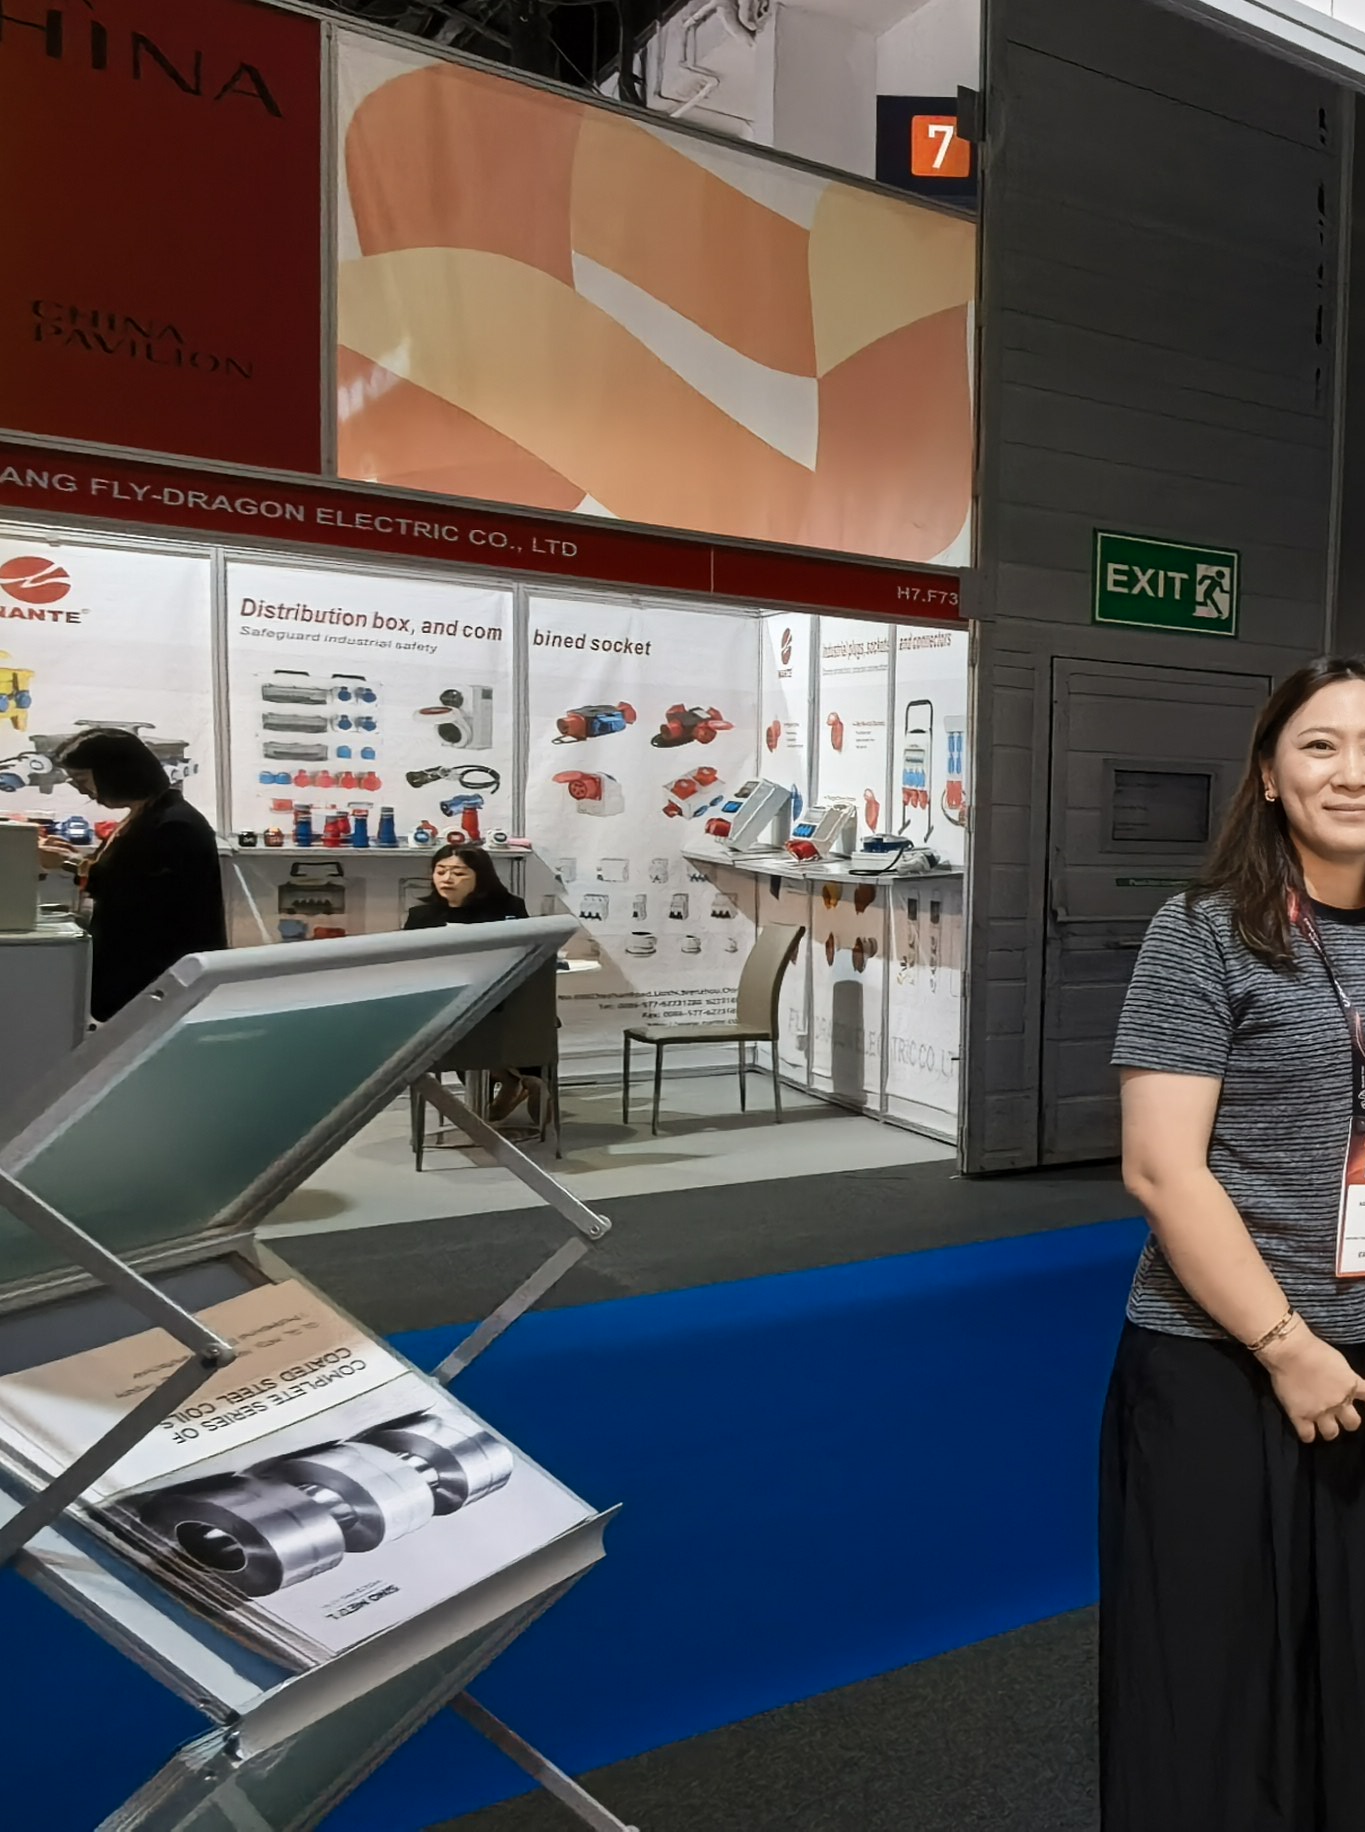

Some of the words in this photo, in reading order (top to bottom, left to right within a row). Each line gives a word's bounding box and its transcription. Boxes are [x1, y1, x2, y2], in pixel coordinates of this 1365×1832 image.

[928, 124, 954, 168] 7
[32, 300, 183, 345] CHINA
[35, 322, 253, 379] PAVILION
[0, 466, 77, 492] ANG
[91, 479, 304, 520] FLY-DRAGON
[317, 508, 459, 542] ELECTRIC
[470, 528, 522, 554] CO.,
[532, 536, 577, 558] LTD
[897, 586, 958, 605] H7.F73
[1107, 563, 1189, 600] EXIT
[240, 598, 367, 629] Distribution
[373, 610, 415, 635] box,
[422, 617, 458, 637] and
[463, 622, 503, 641] com
[240, 624, 320, 645] Safeguard
[534, 629, 586, 651] bined
[590, 635, 651, 656] socket
[273, 1359, 366, 1406] COMPLETE
[279, 1347, 352, 1382] COATED
[216, 1379, 278, 1403] STEEL
[200, 1400, 268, 1432] SERIES
[172, 1428, 199, 1444] OF
